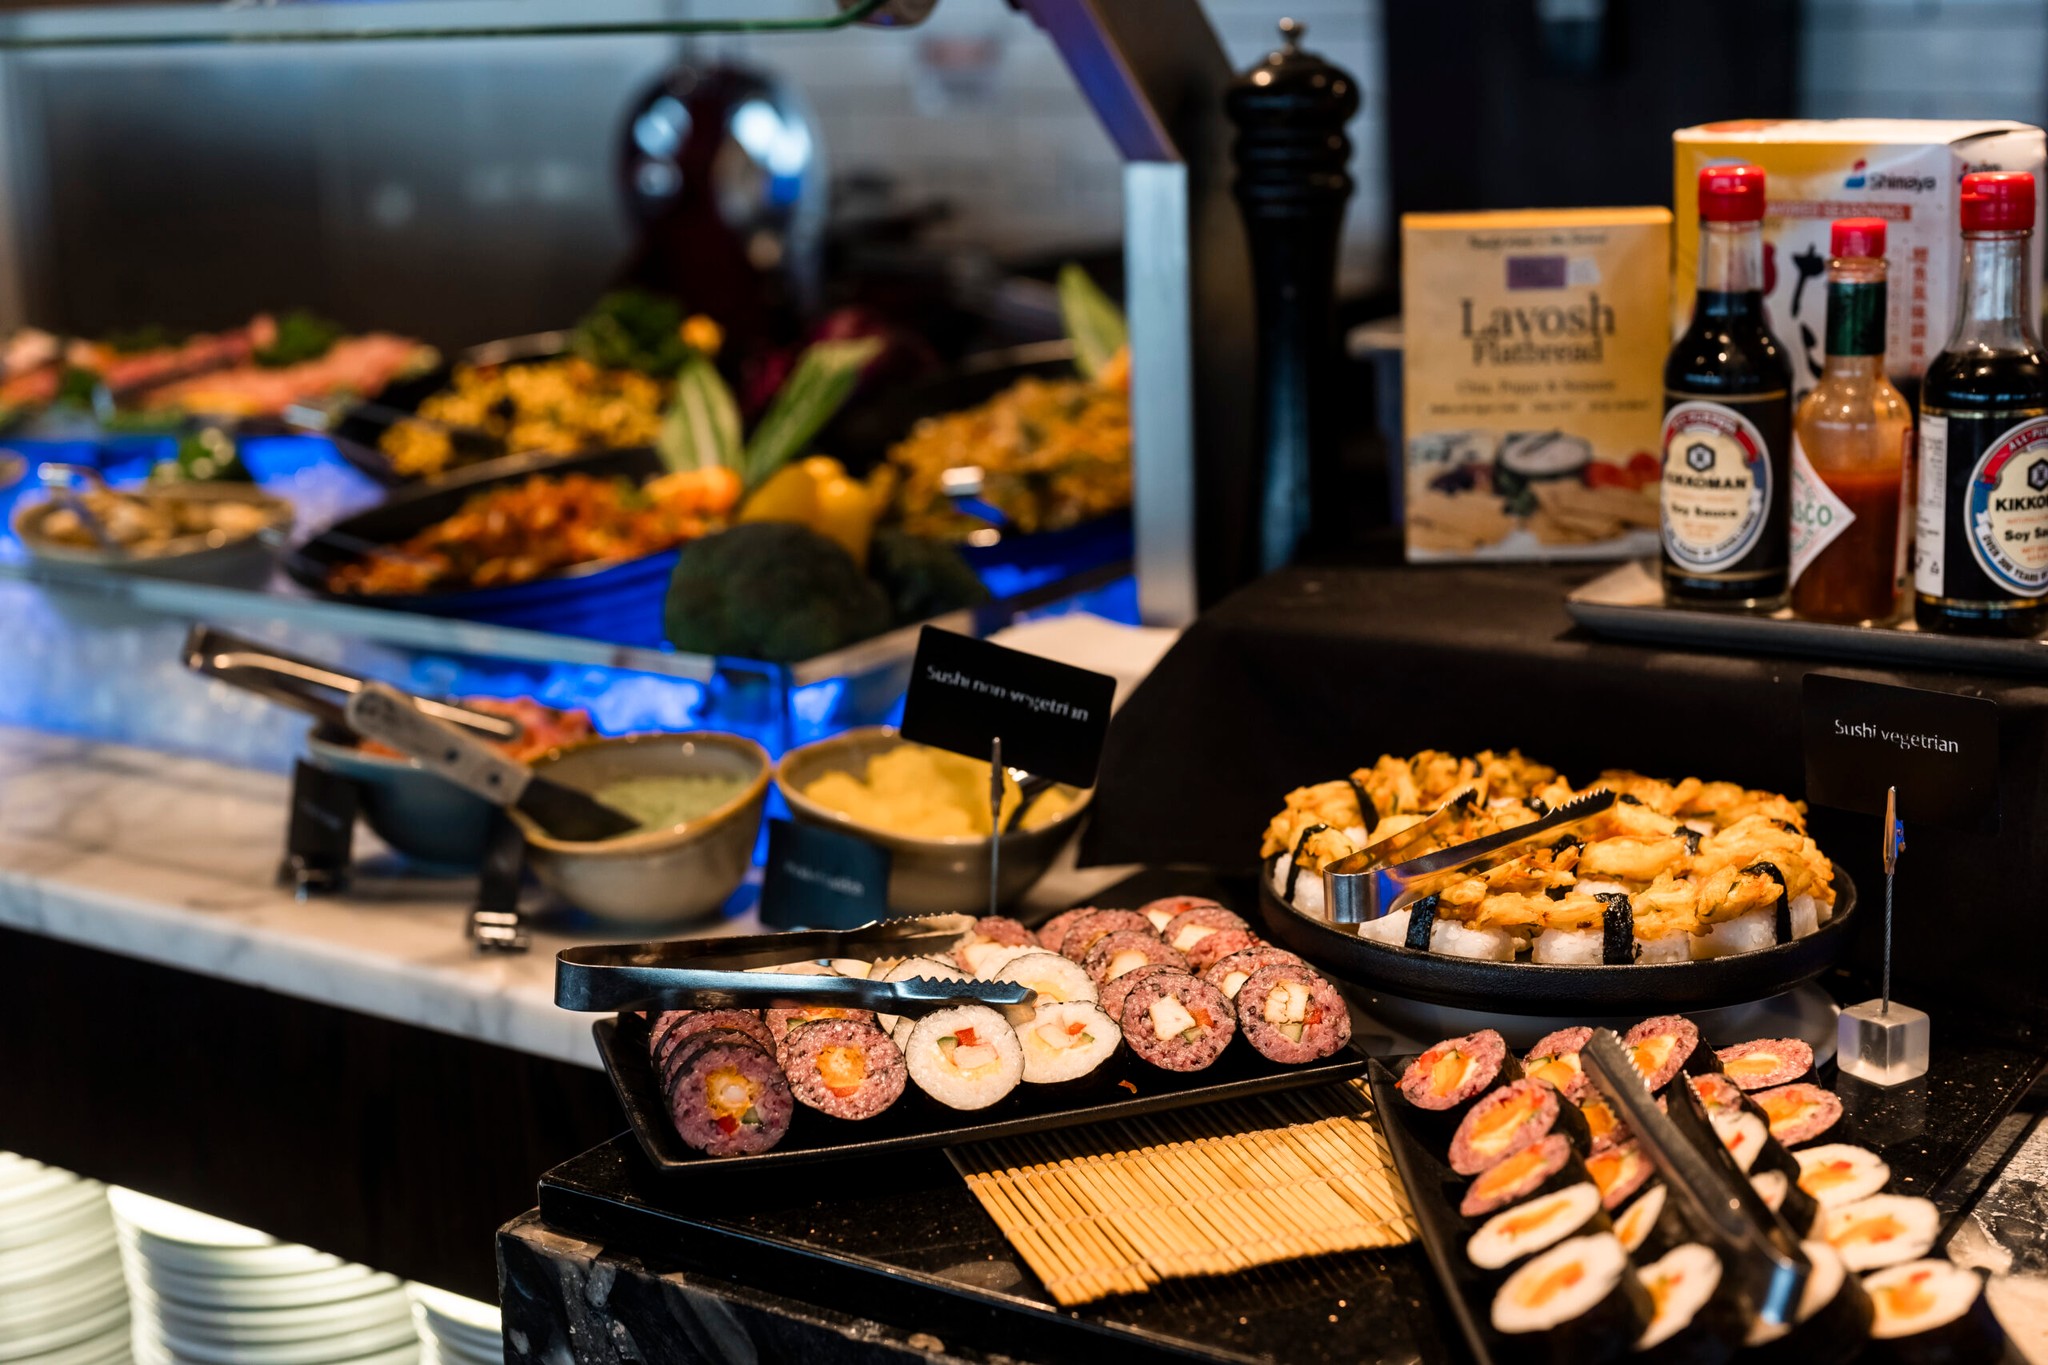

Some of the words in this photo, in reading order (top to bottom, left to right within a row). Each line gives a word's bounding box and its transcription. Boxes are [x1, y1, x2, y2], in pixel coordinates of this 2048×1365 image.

[1870, 172, 1936, 193] Shimaya
[1460, 291, 1615, 341] Lavosh
[1472, 335, 1604, 365] Flatbread
[1995, 494, 2048, 511] KIKKO
[2004, 529, 2030, 543] Soy
[927, 664, 968, 689] Sushi
[972, 681, 1006, 699] non
[1835, 718, 1877, 738] Sushi
[1881, 728, 1959, 753] vegetrian
